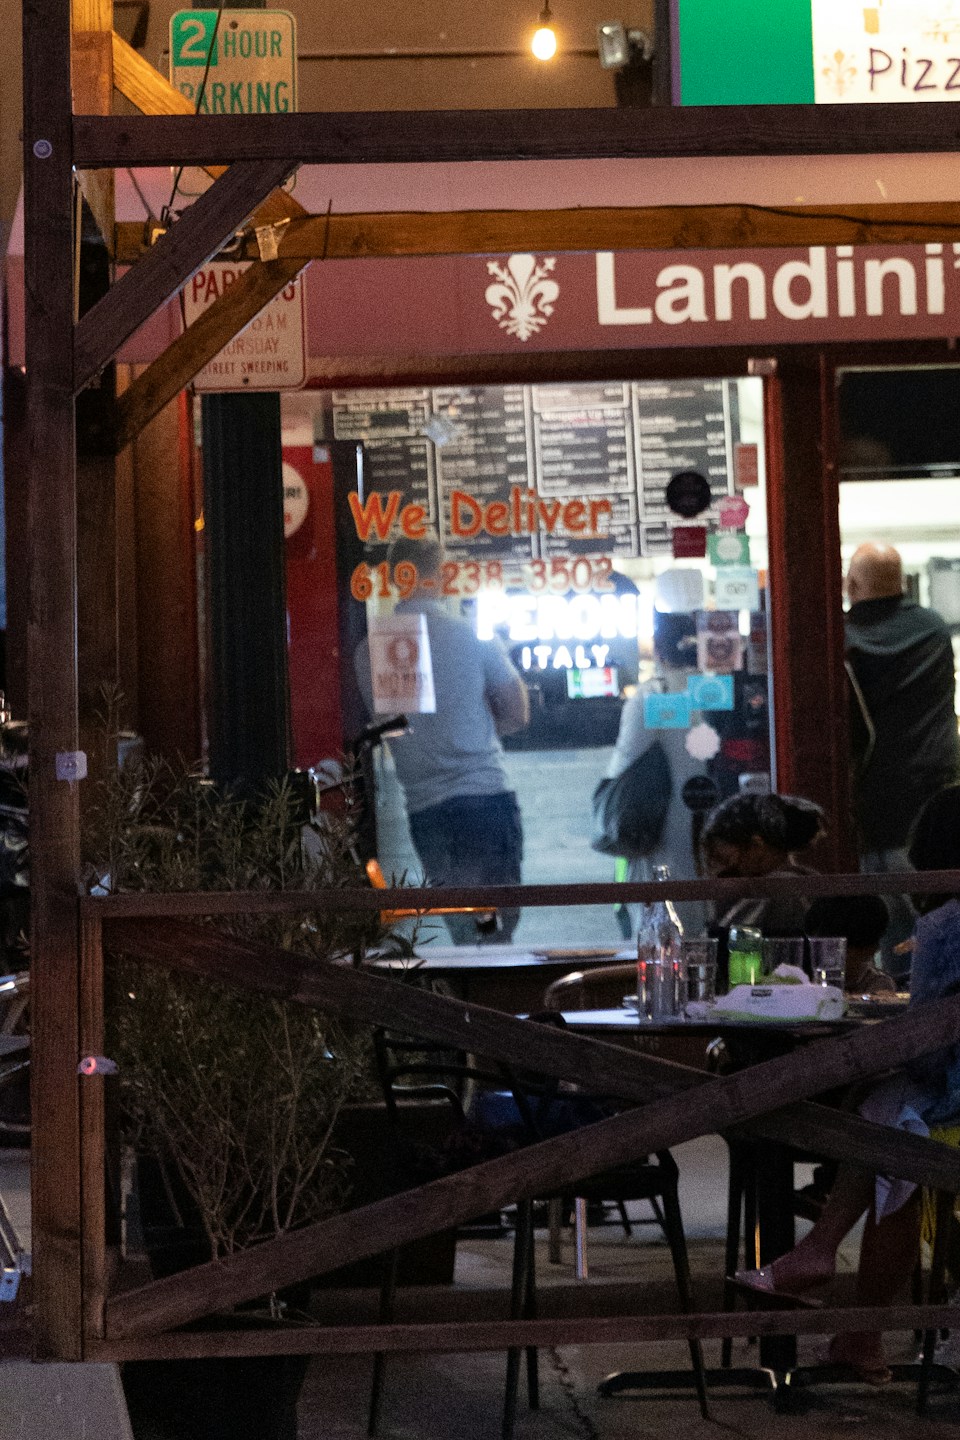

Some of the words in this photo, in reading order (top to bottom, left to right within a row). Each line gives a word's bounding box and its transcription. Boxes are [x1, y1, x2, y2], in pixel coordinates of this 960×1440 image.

[180, 19, 206, 58] 2
[223, 29, 282, 58] HOUR
[348, 490, 428, 541] We
[450, 484, 612, 538] Deliver
[350, 557, 615, 602] 619-238-3502
[476, 592, 656, 641] PERONI
[521, 644, 610, 671] ITALY
